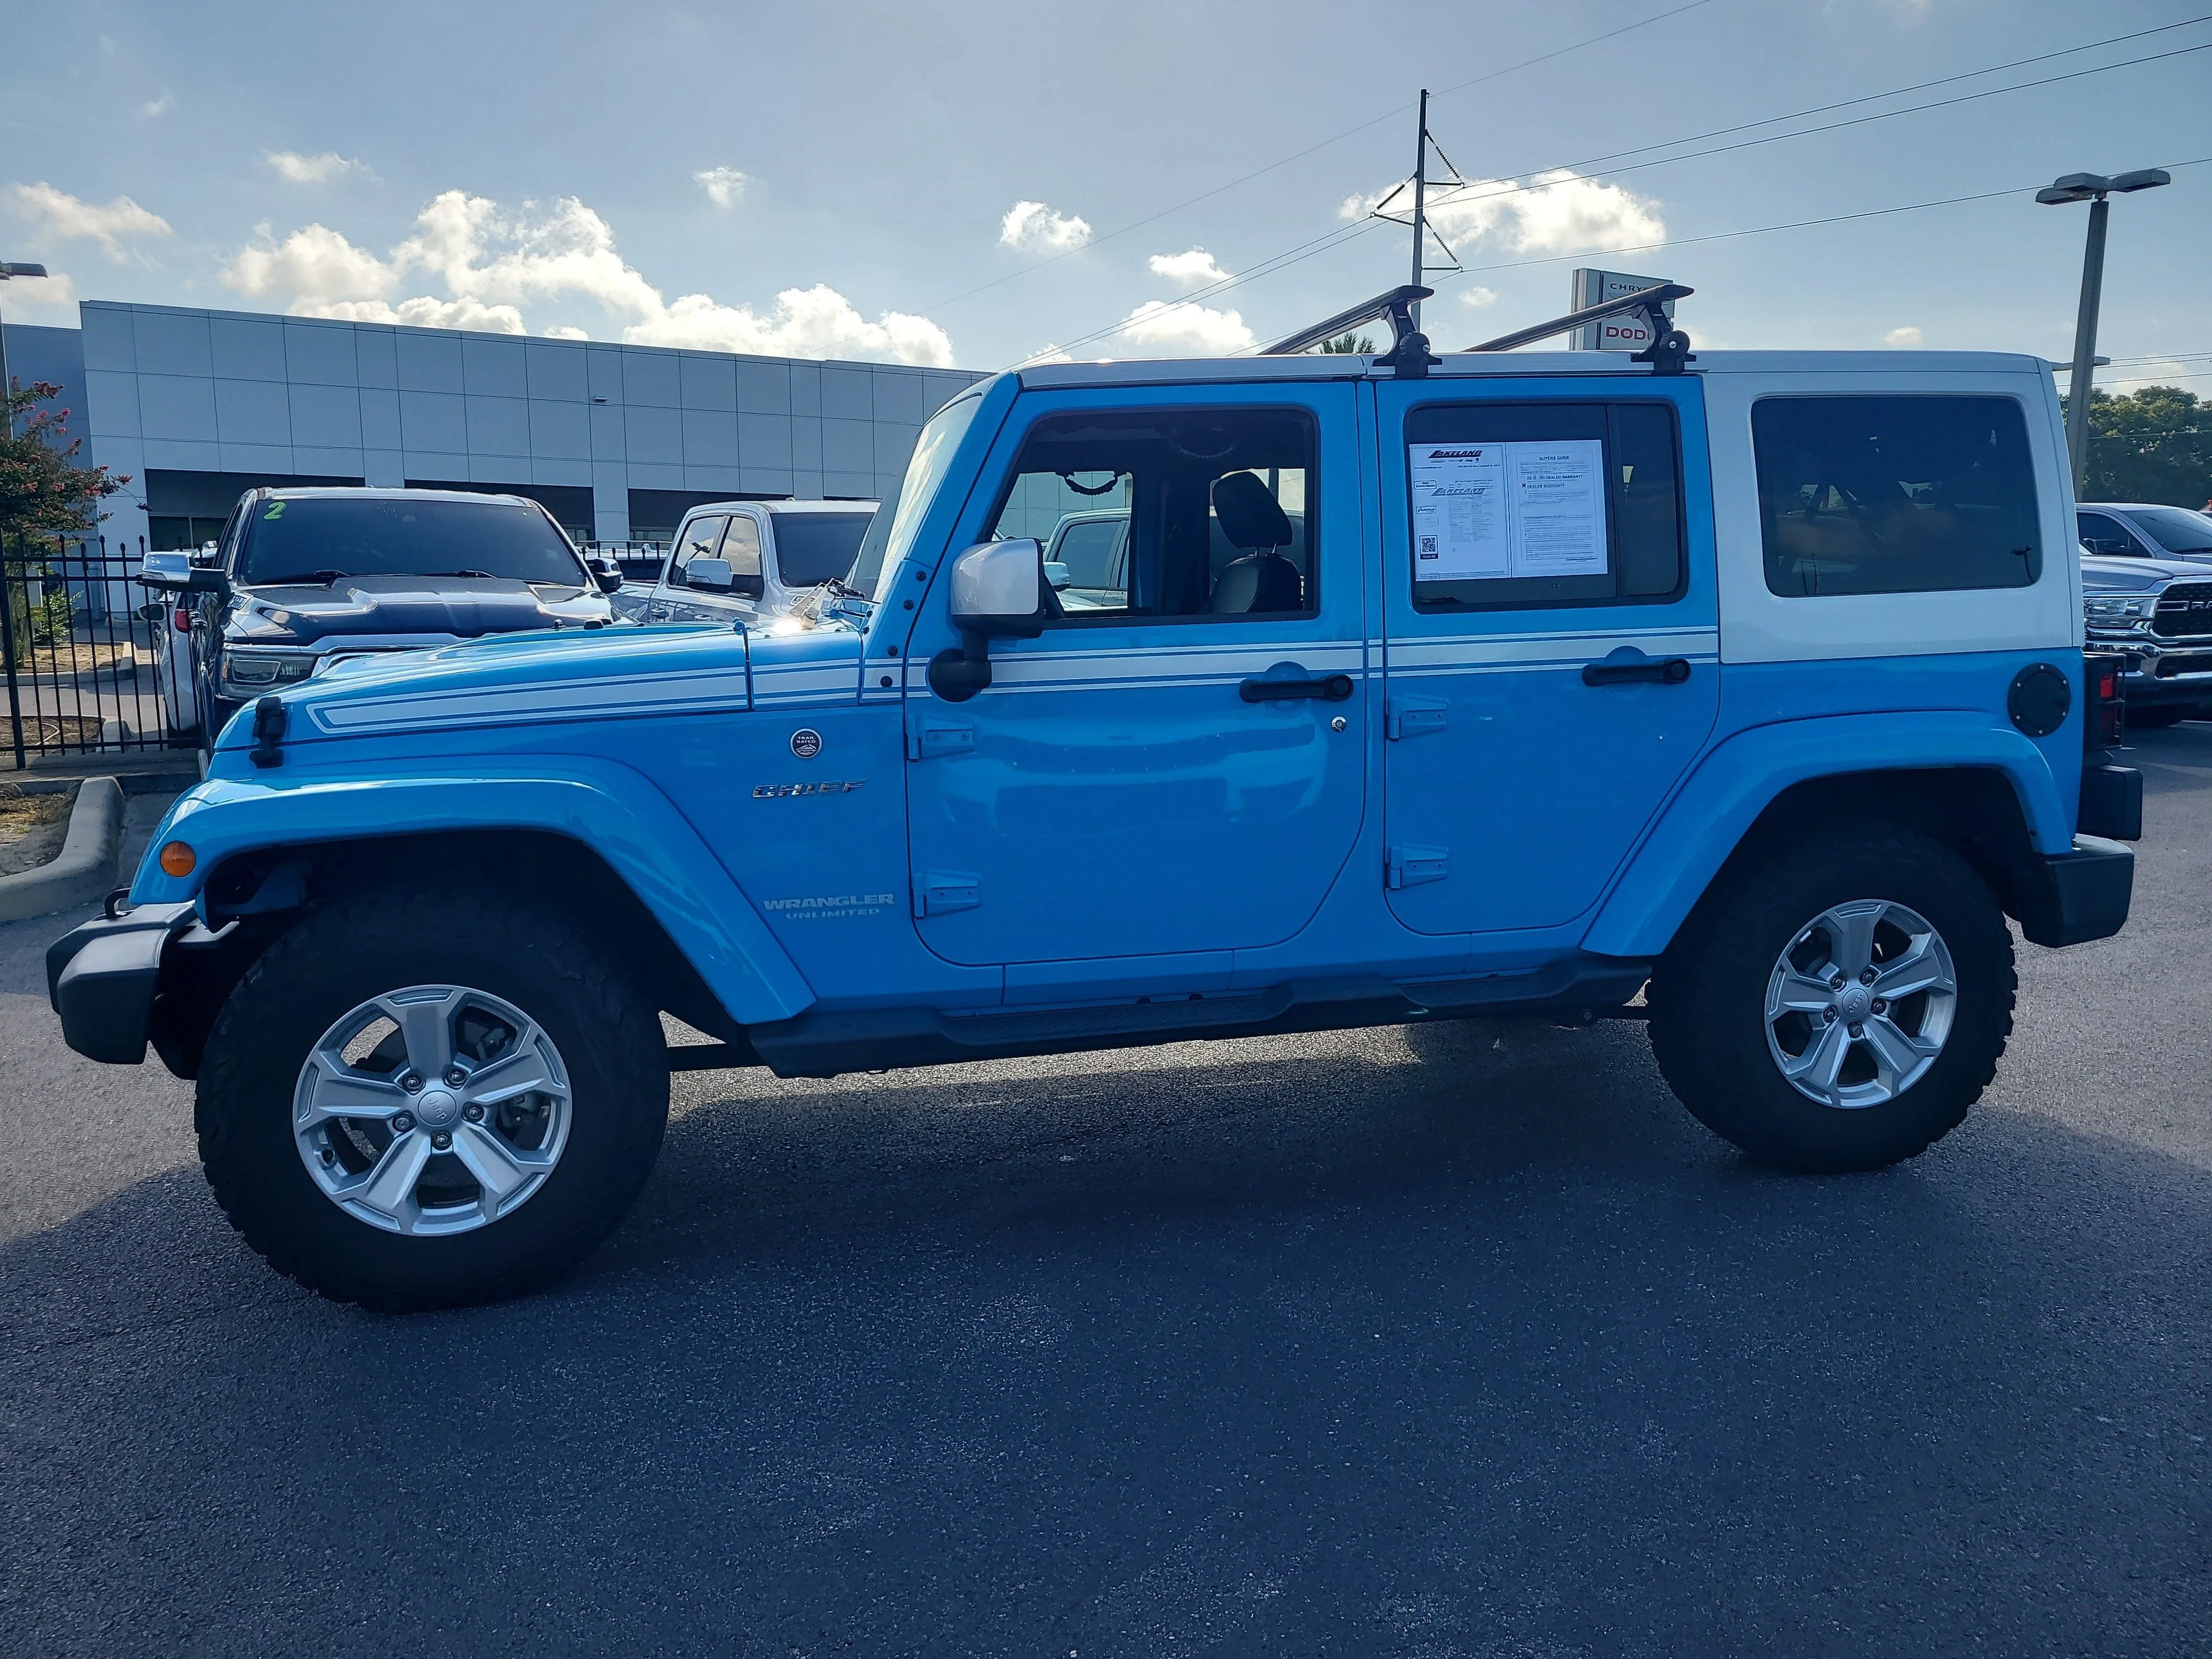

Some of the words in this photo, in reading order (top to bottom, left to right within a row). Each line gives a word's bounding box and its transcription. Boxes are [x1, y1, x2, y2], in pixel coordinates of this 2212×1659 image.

[1610, 283, 1649, 291] CHRY
[1606, 326, 1650, 340] DOD
[1428, 450, 1483, 459] LAKELAND
[263, 501, 287, 520] 2
[752, 778, 867, 798] CHIEF
[763, 894, 895, 910] WRANGLER
[786, 908, 880, 919] UNLIMITED
[1848, 994, 1863, 1013] Jeep
[428, 1098, 447, 1119] Jeep
